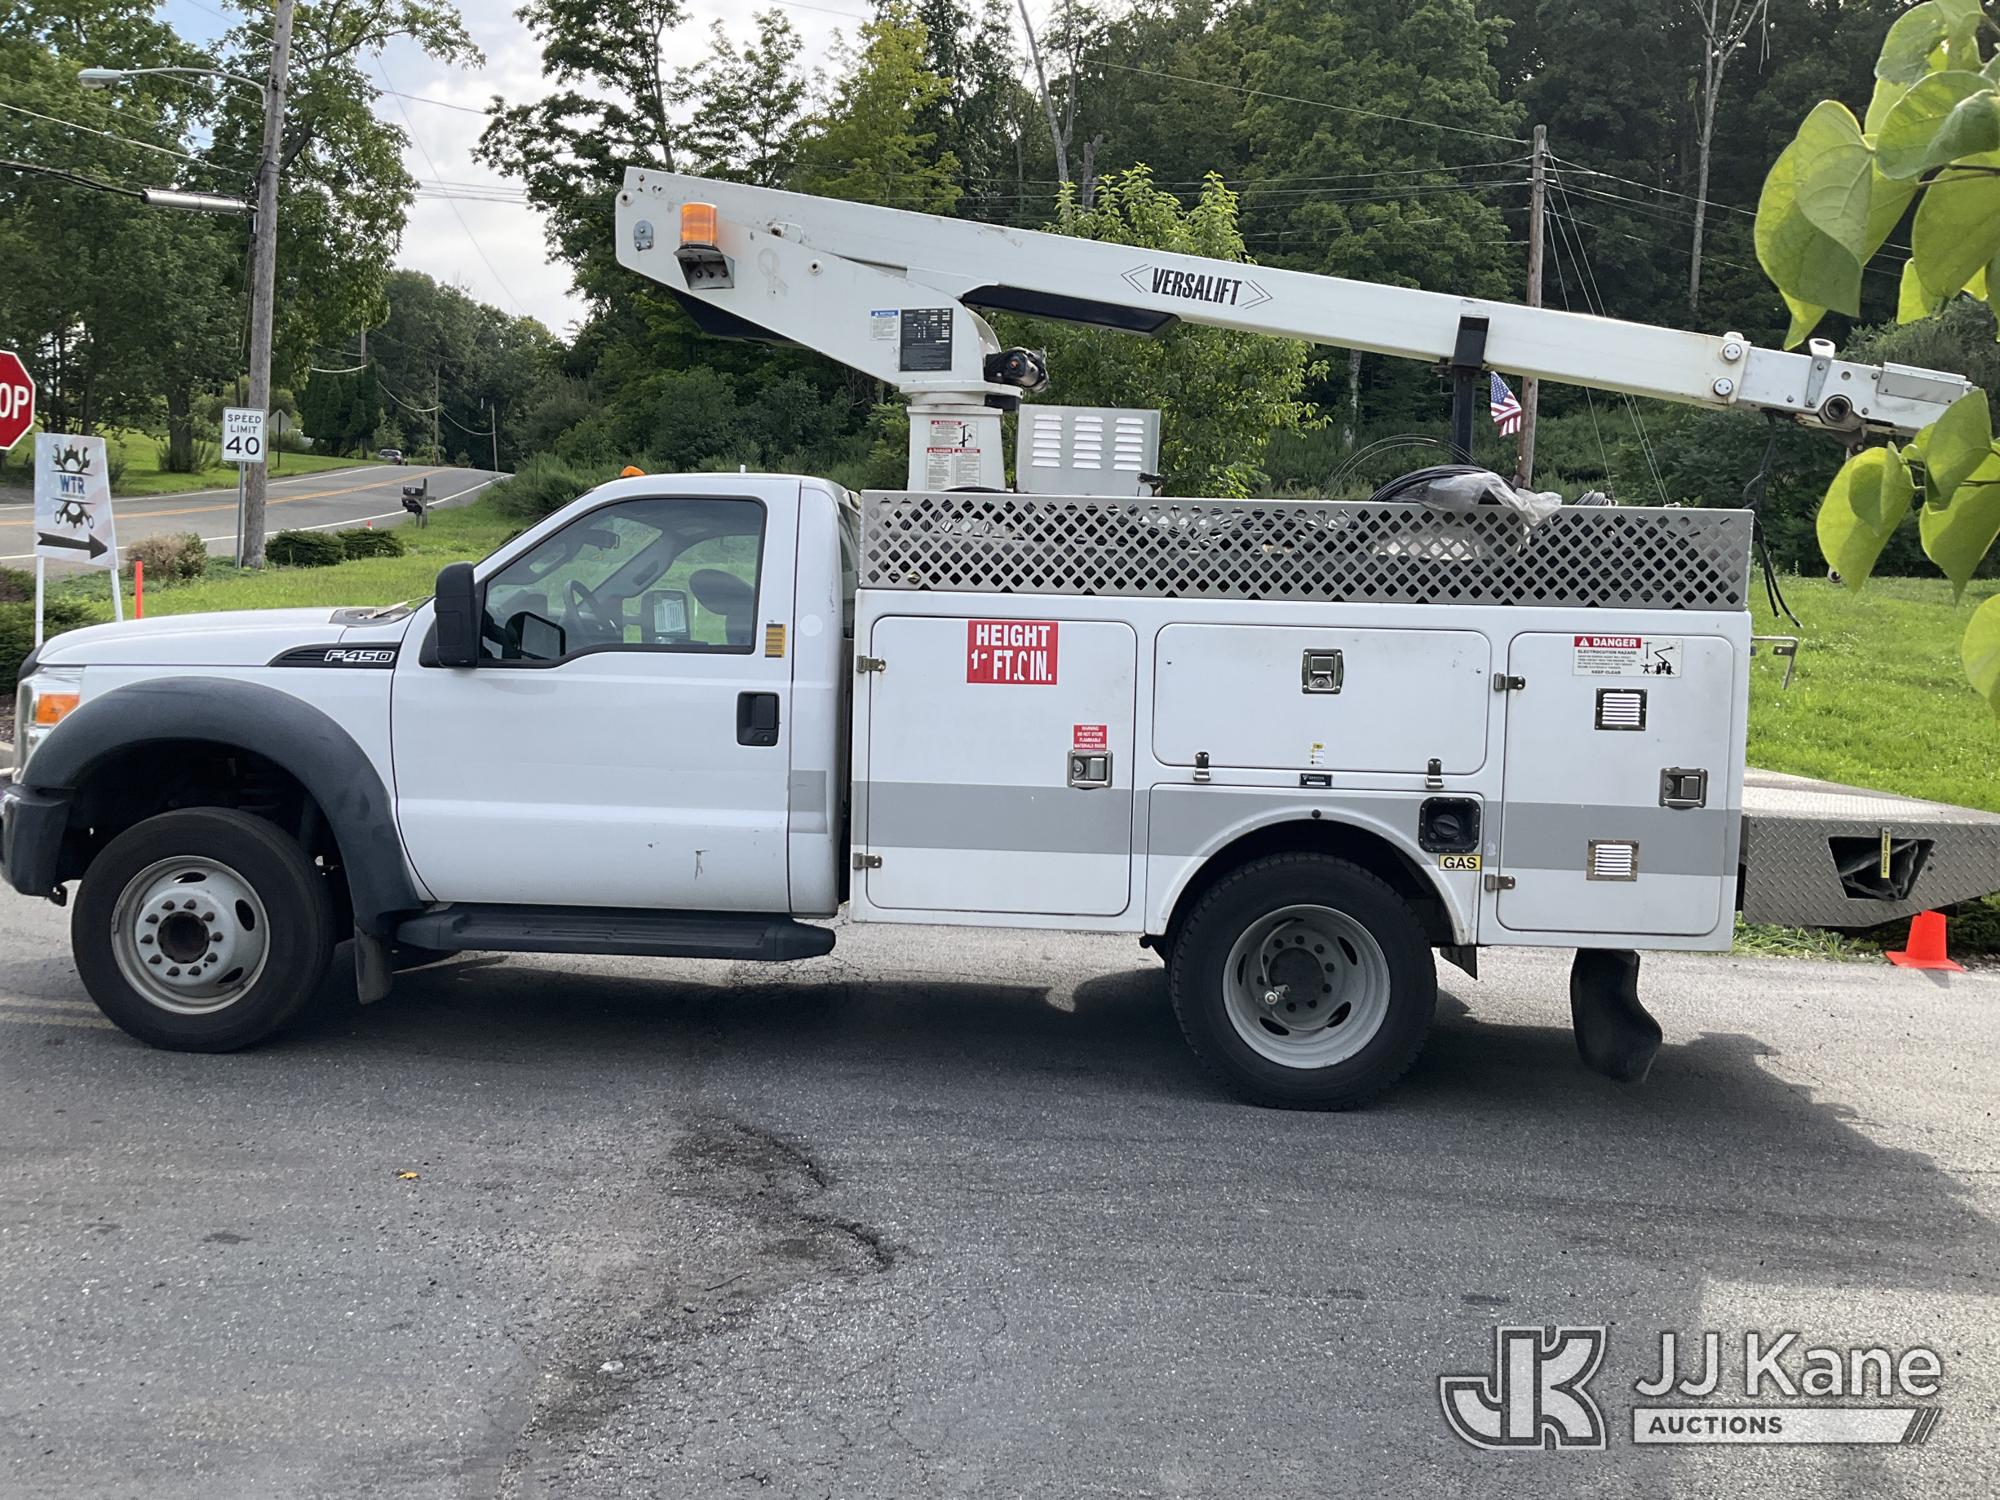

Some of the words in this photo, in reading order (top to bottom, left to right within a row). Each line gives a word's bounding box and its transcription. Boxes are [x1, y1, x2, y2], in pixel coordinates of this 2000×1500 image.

[1151, 267, 1242, 306] VERSALIFT
[0, 382, 30, 419] OP
[227, 413, 262, 424] SPEED
[230, 425, 257, 434] LIMIT
[226, 435, 260, 455] 40
[60, 474, 86, 495] WTR
[975, 623, 1051, 647] HEIGHT
[1592, 638, 1637, 648] DANGER
[1443, 856, 1477, 869] GAS
